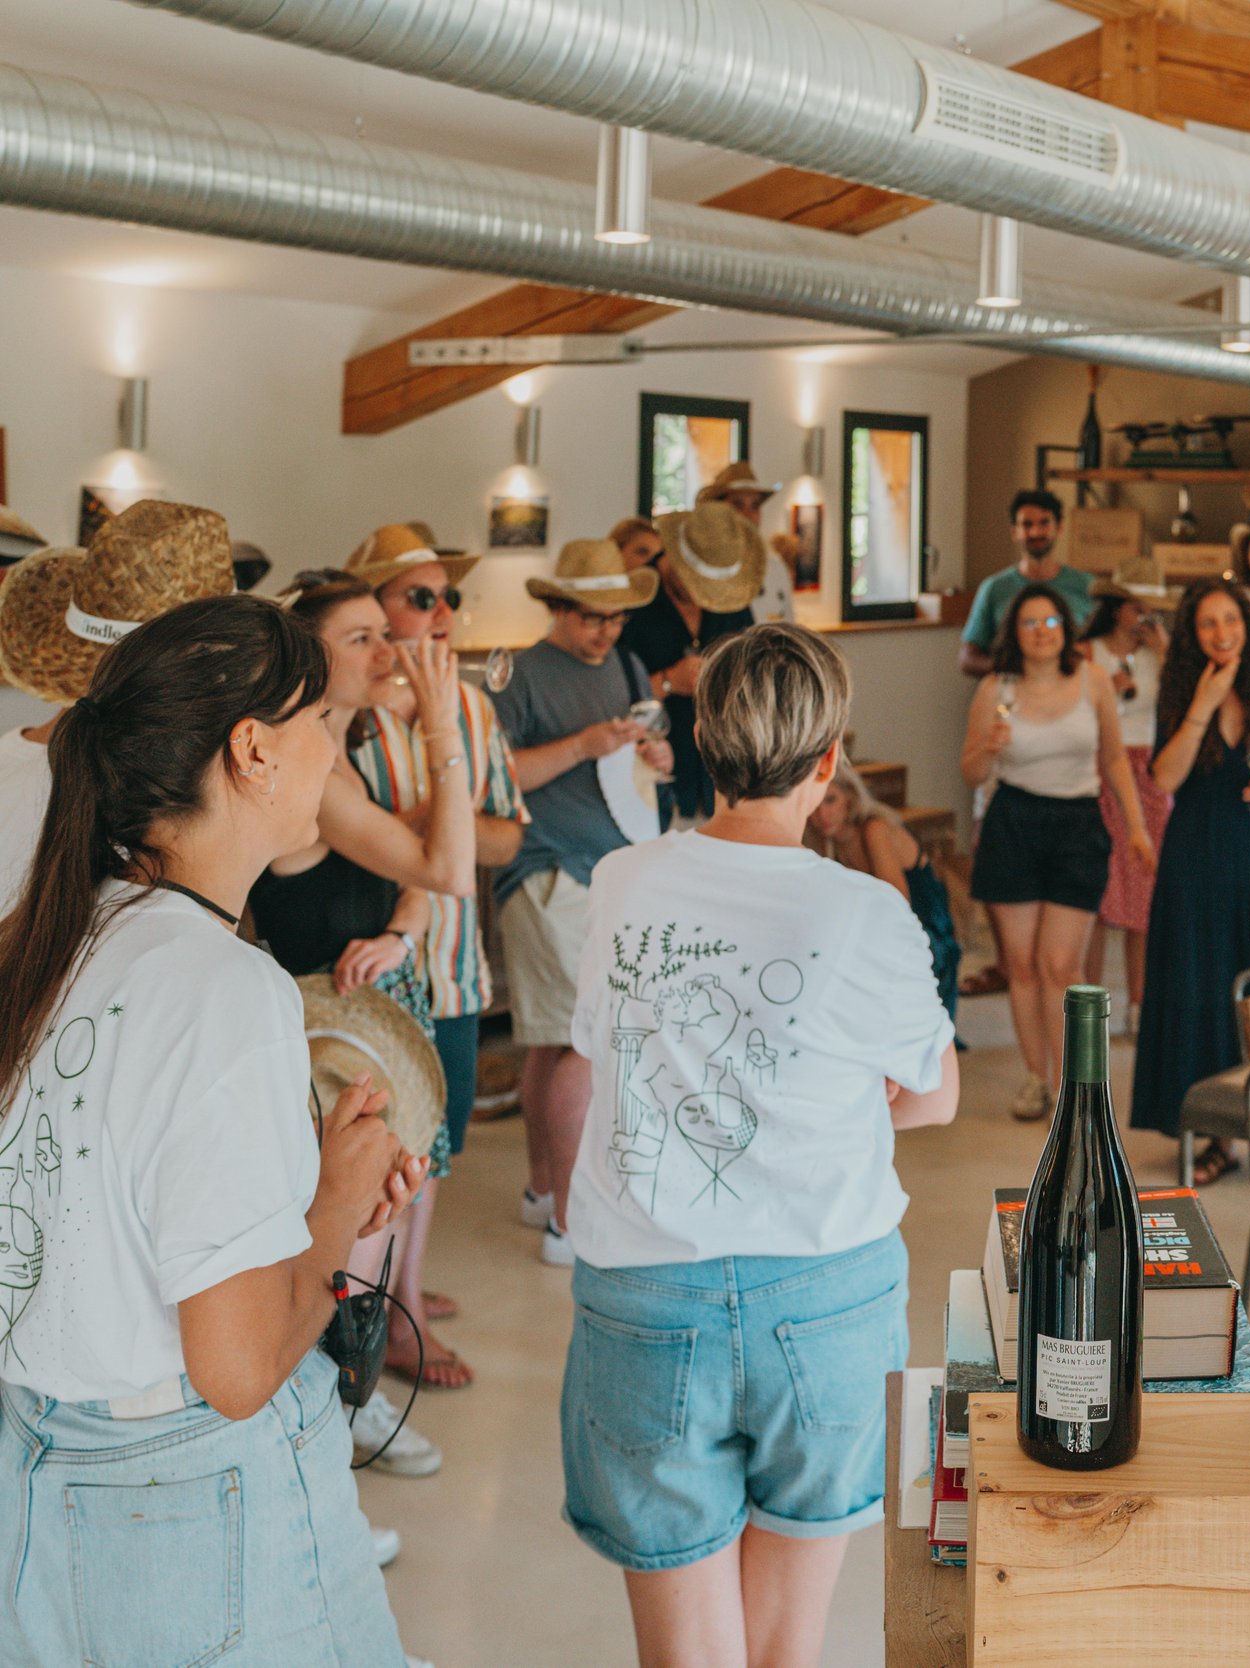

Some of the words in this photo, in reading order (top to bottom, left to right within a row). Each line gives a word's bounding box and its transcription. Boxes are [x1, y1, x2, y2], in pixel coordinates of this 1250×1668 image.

[1145, 1249, 1189, 1262] SH
[1042, 1340, 1057, 1352] MAS
[1060, 1343, 1106, 1355] BRUGUIERE
[1041, 1353, 1053, 1361] PIC
[1057, 1357, 1106, 1366] SAINT-LOUP
